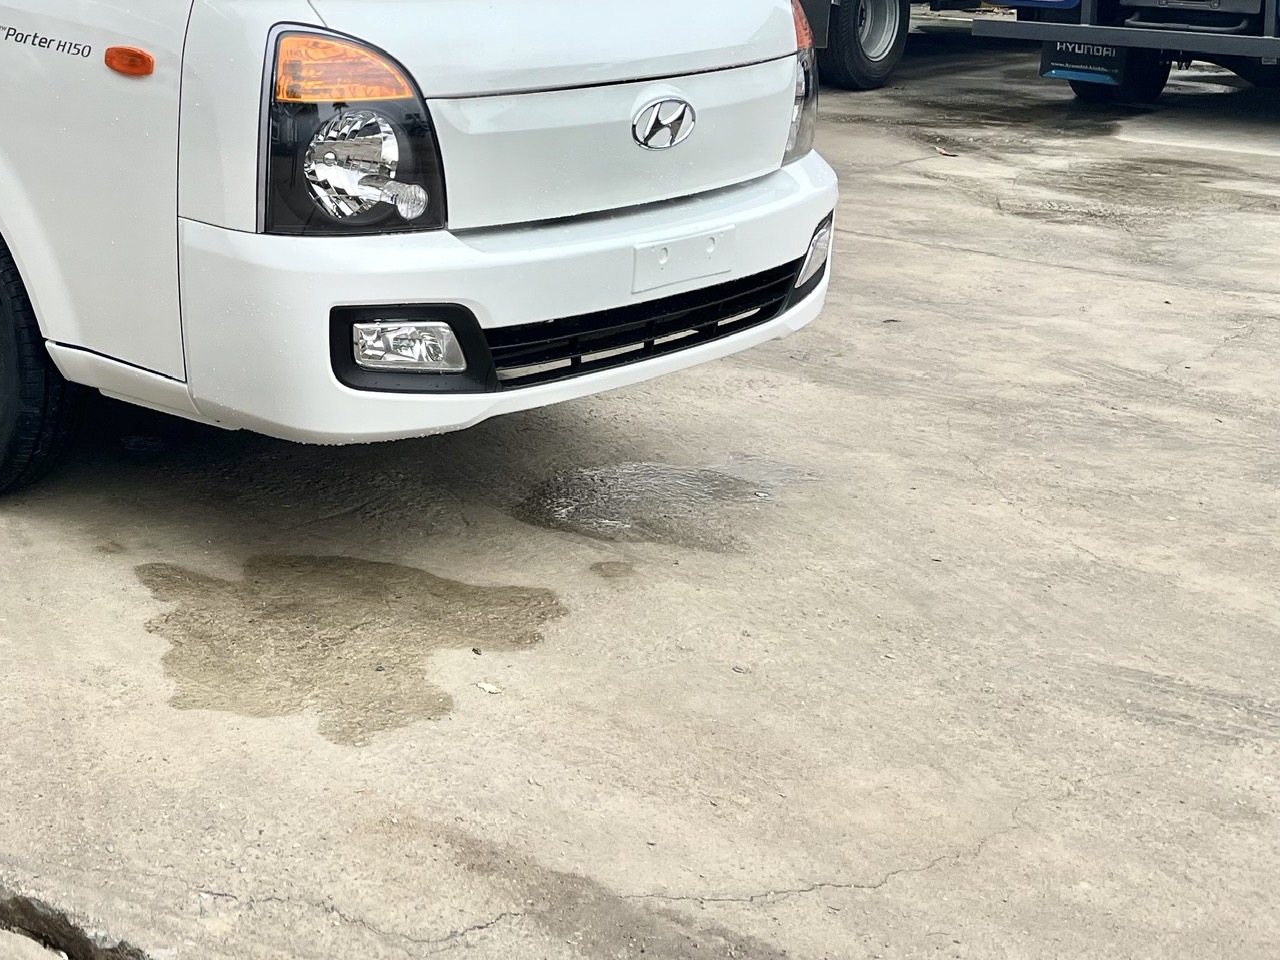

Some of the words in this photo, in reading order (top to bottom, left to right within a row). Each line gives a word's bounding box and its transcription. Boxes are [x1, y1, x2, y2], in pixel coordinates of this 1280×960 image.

[5, 27, 56, 50] Porter
[56, 40, 92, 58] H150
[1056, 41, 1116, 57] HYUNDAI
